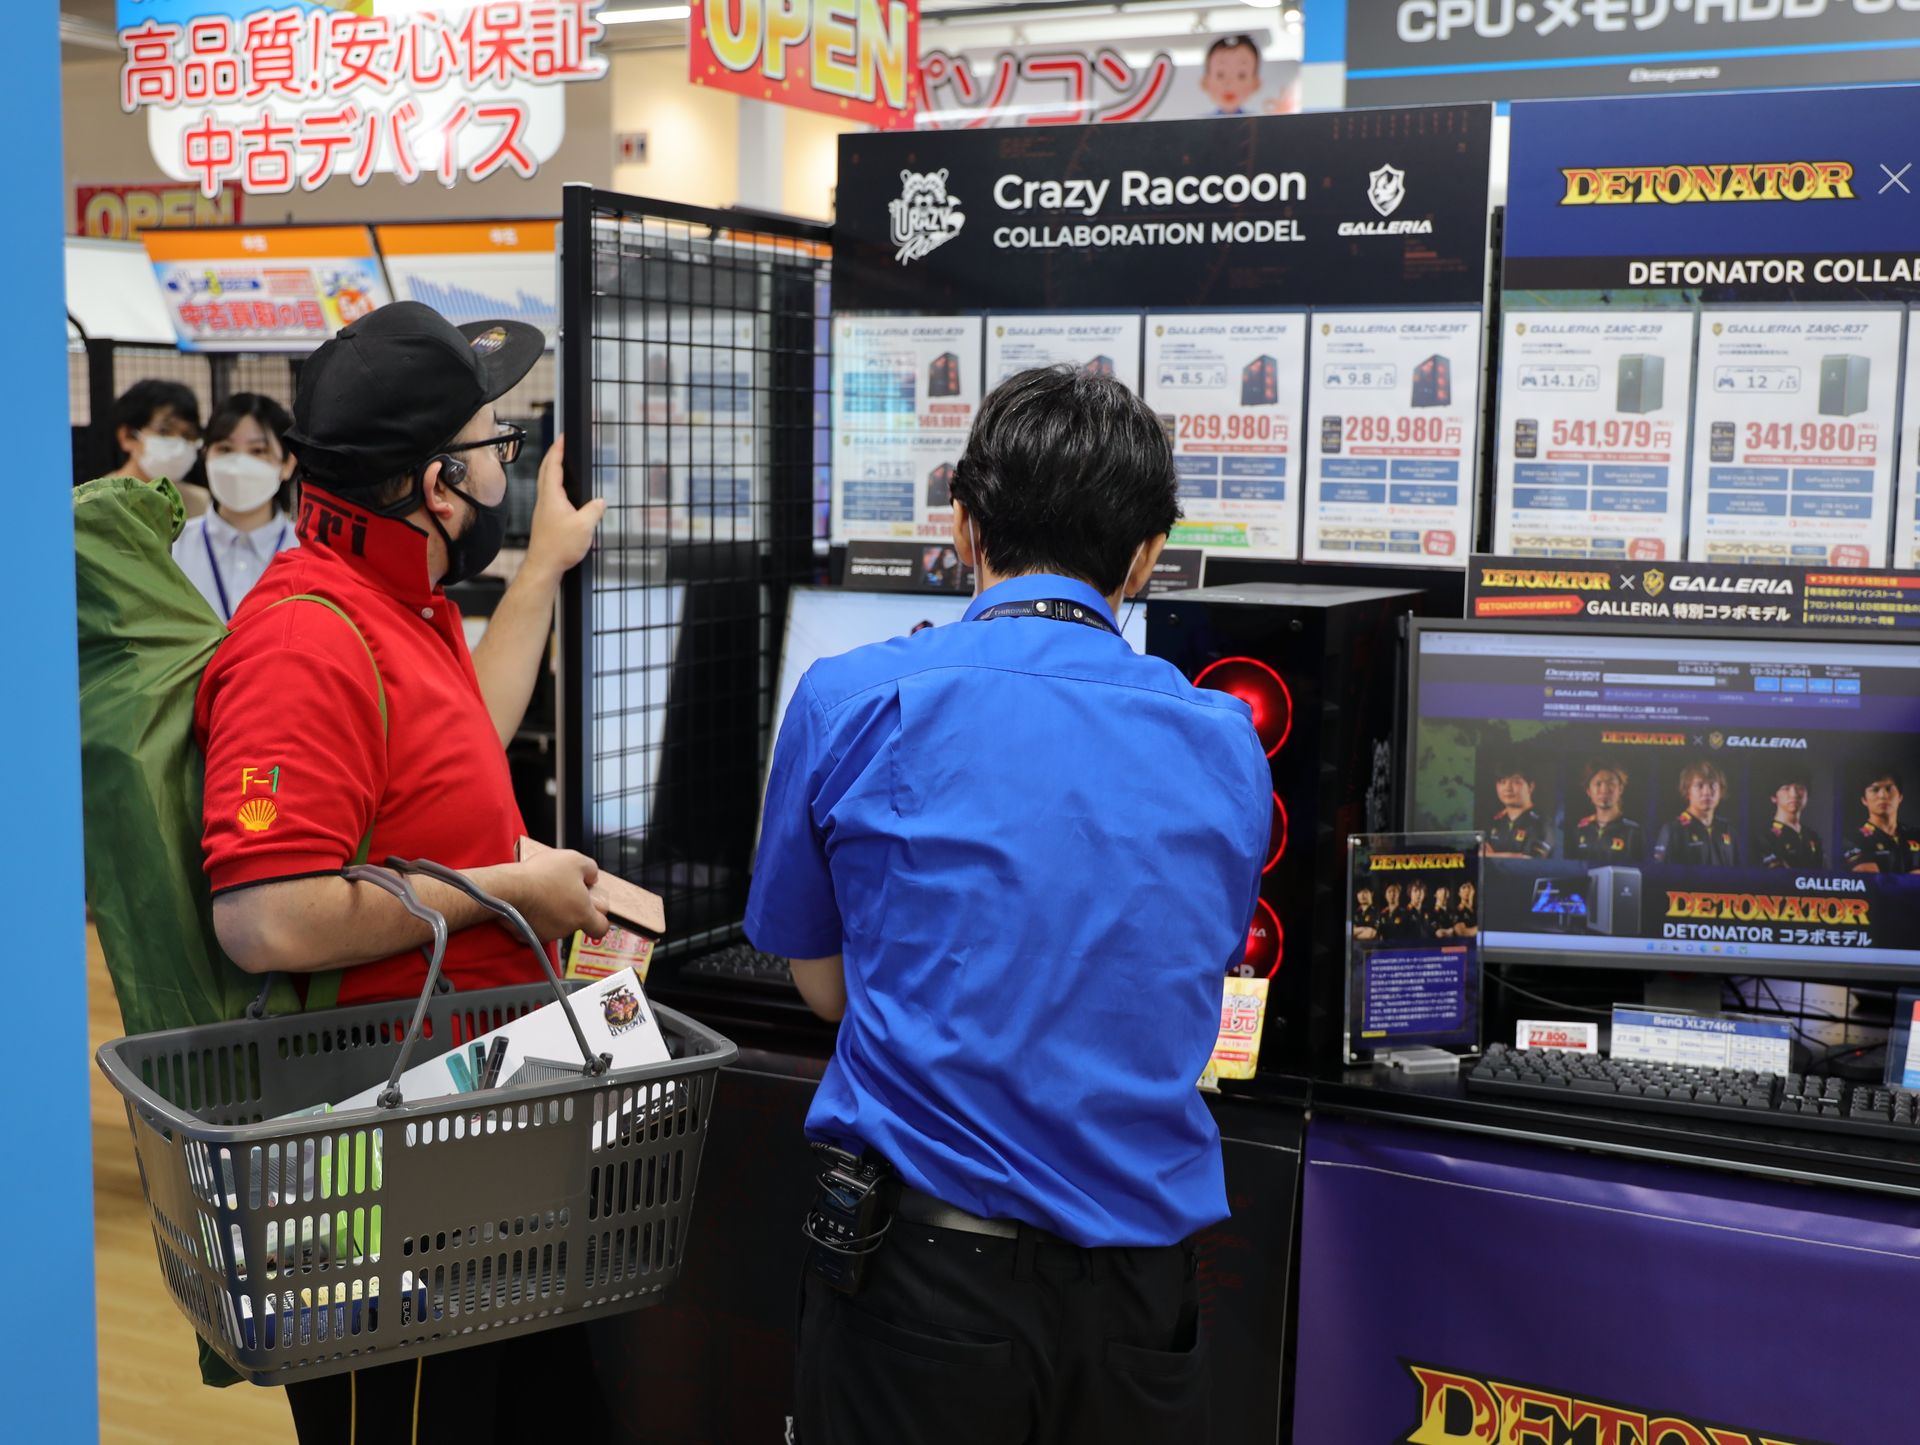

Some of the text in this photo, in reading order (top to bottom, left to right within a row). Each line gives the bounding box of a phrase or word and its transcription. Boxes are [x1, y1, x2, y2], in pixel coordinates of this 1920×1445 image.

[704, 0, 907, 107] OPEN
[184, 102, 534, 192] 中古デバイス
[993, 170, 1307, 216] Crazy Raccoon
[1561, 161, 1856, 206] DETONATOR
[993, 220, 1306, 249] COLLABORATION MODEL
[1337, 220, 1433, 236] GALLERIA
[1628, 260, 1804, 285] DETONATOR
[1334, 324, 1397, 334] GALLERIA
[1530, 324, 1600, 334] GALLERIA
[1727, 323, 1869, 334] GALLERIA ZA9C-R37
[1481, 568, 1612, 591] DETONATOR
[1669, 576, 1794, 595] GALLERIA
[1586, 600, 1792, 622] GALLERIA 特別コラボモデル
[1601, 732, 1686, 746] DETONATOR
[1726, 736, 1808, 750] GALLERIA
[242, 766, 280, 795] F-1
[1369, 853, 1466, 870] DETONATOR
[1795, 876, 1866, 893] GALLERIA
[1665, 890, 1871, 926] DETONATOR
[1663, 922, 1873, 947] DETONATOR コラボモデル
[1653, 1015, 1683, 1028] BenQ
